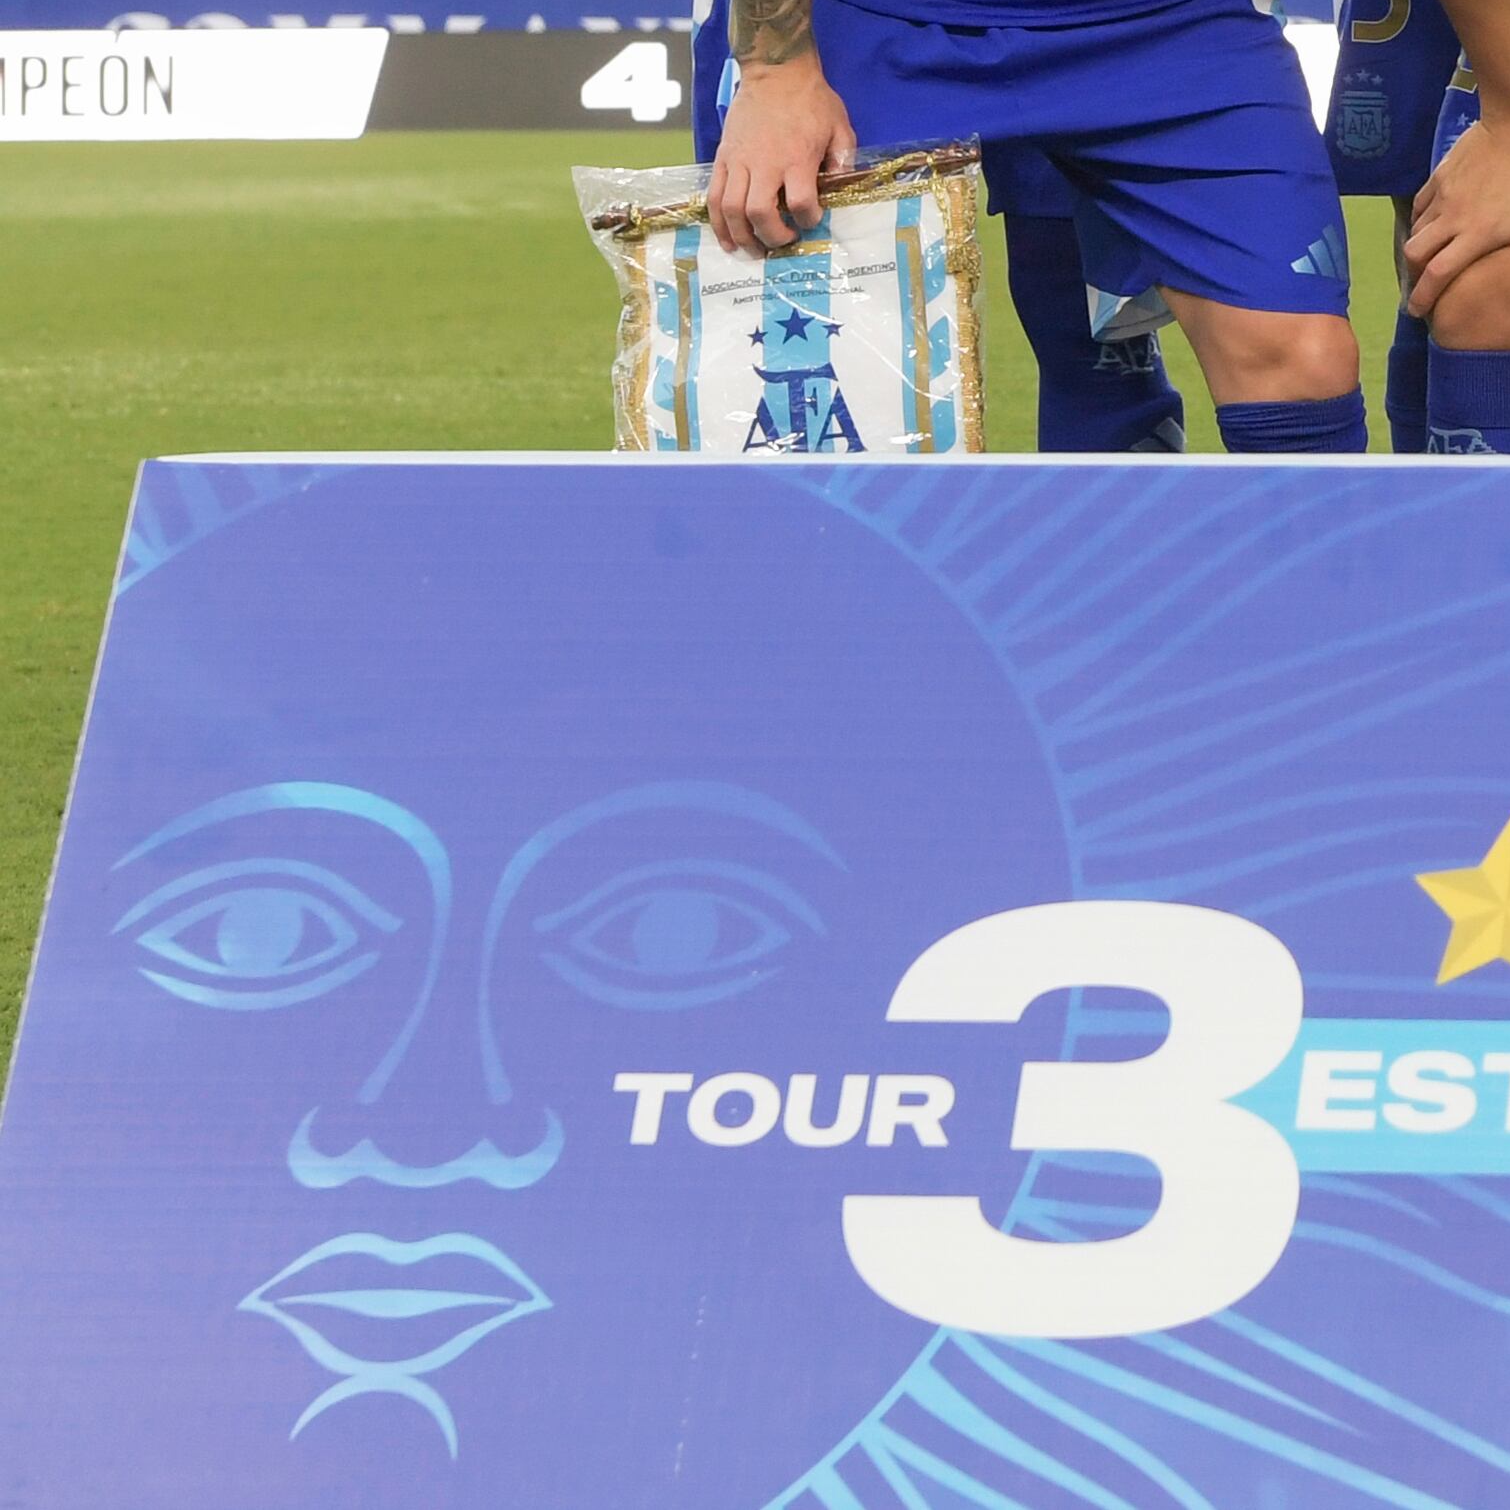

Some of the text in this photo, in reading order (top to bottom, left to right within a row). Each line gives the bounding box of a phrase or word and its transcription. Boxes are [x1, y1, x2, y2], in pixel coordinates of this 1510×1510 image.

[580, 42, 682, 122] 4
[742, 362, 868, 453] AFA
[612, 1071, 956, 1148] TOUR
[842, 900, 1304, 1339] 3
